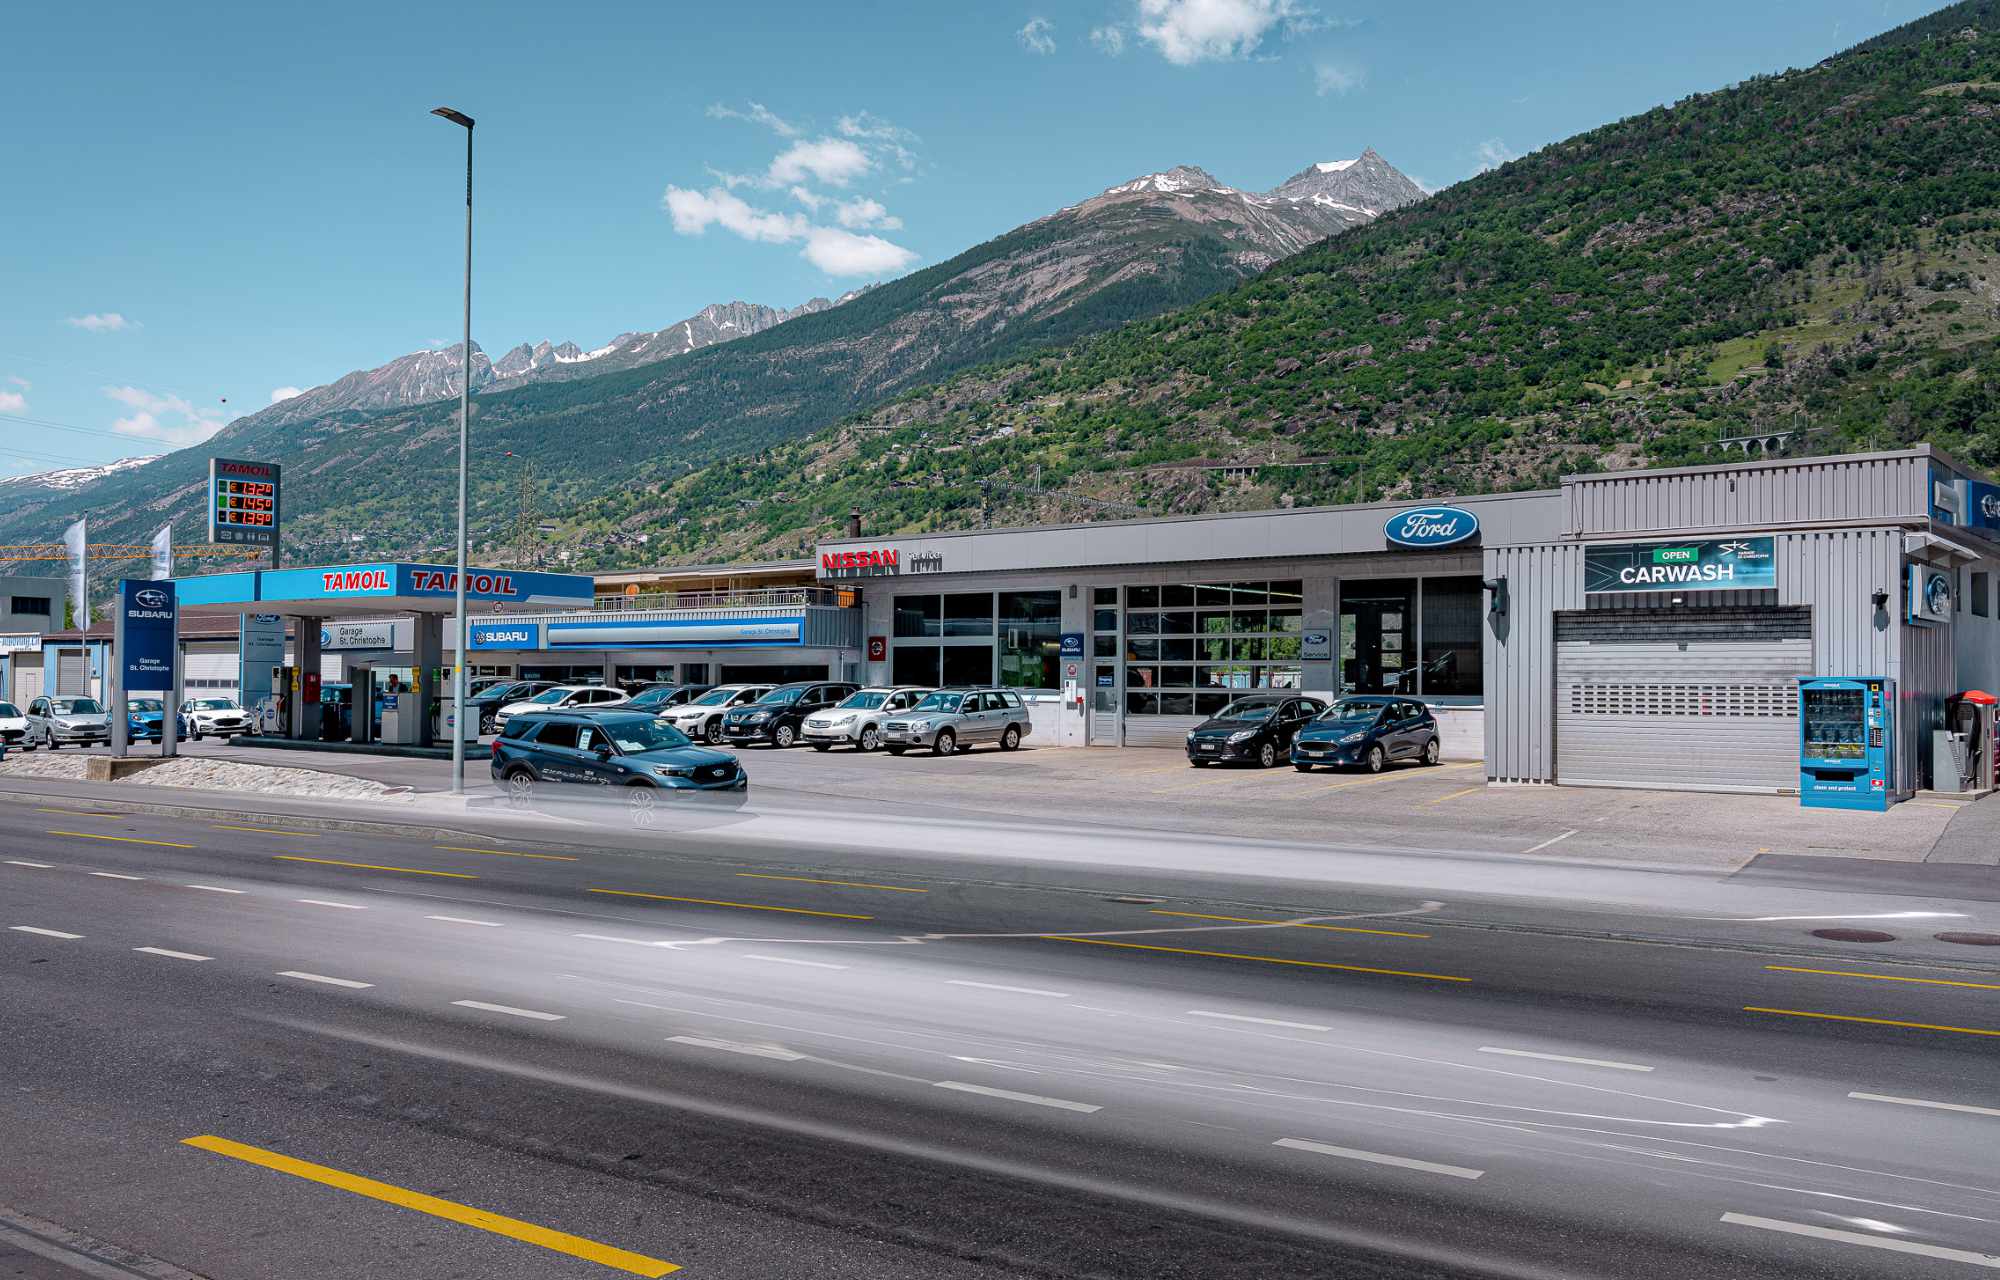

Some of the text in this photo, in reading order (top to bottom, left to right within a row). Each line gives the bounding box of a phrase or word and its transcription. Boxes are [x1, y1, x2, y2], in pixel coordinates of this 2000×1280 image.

[222, 464, 271, 476] TAMOIL
[1401, 513, 1457, 538] Ford
[822, 549, 897, 568] NISSAN
[1662, 551, 1691, 560] OPEN
[1620, 564, 1734, 584] CARWASH
[323, 571, 389, 590] TAMOIL
[128, 610, 173, 619] SUBARU
[340, 627, 363, 637] Garage
[486, 632, 528, 642] SUBARU
[350, 636, 386, 647] Christophe
